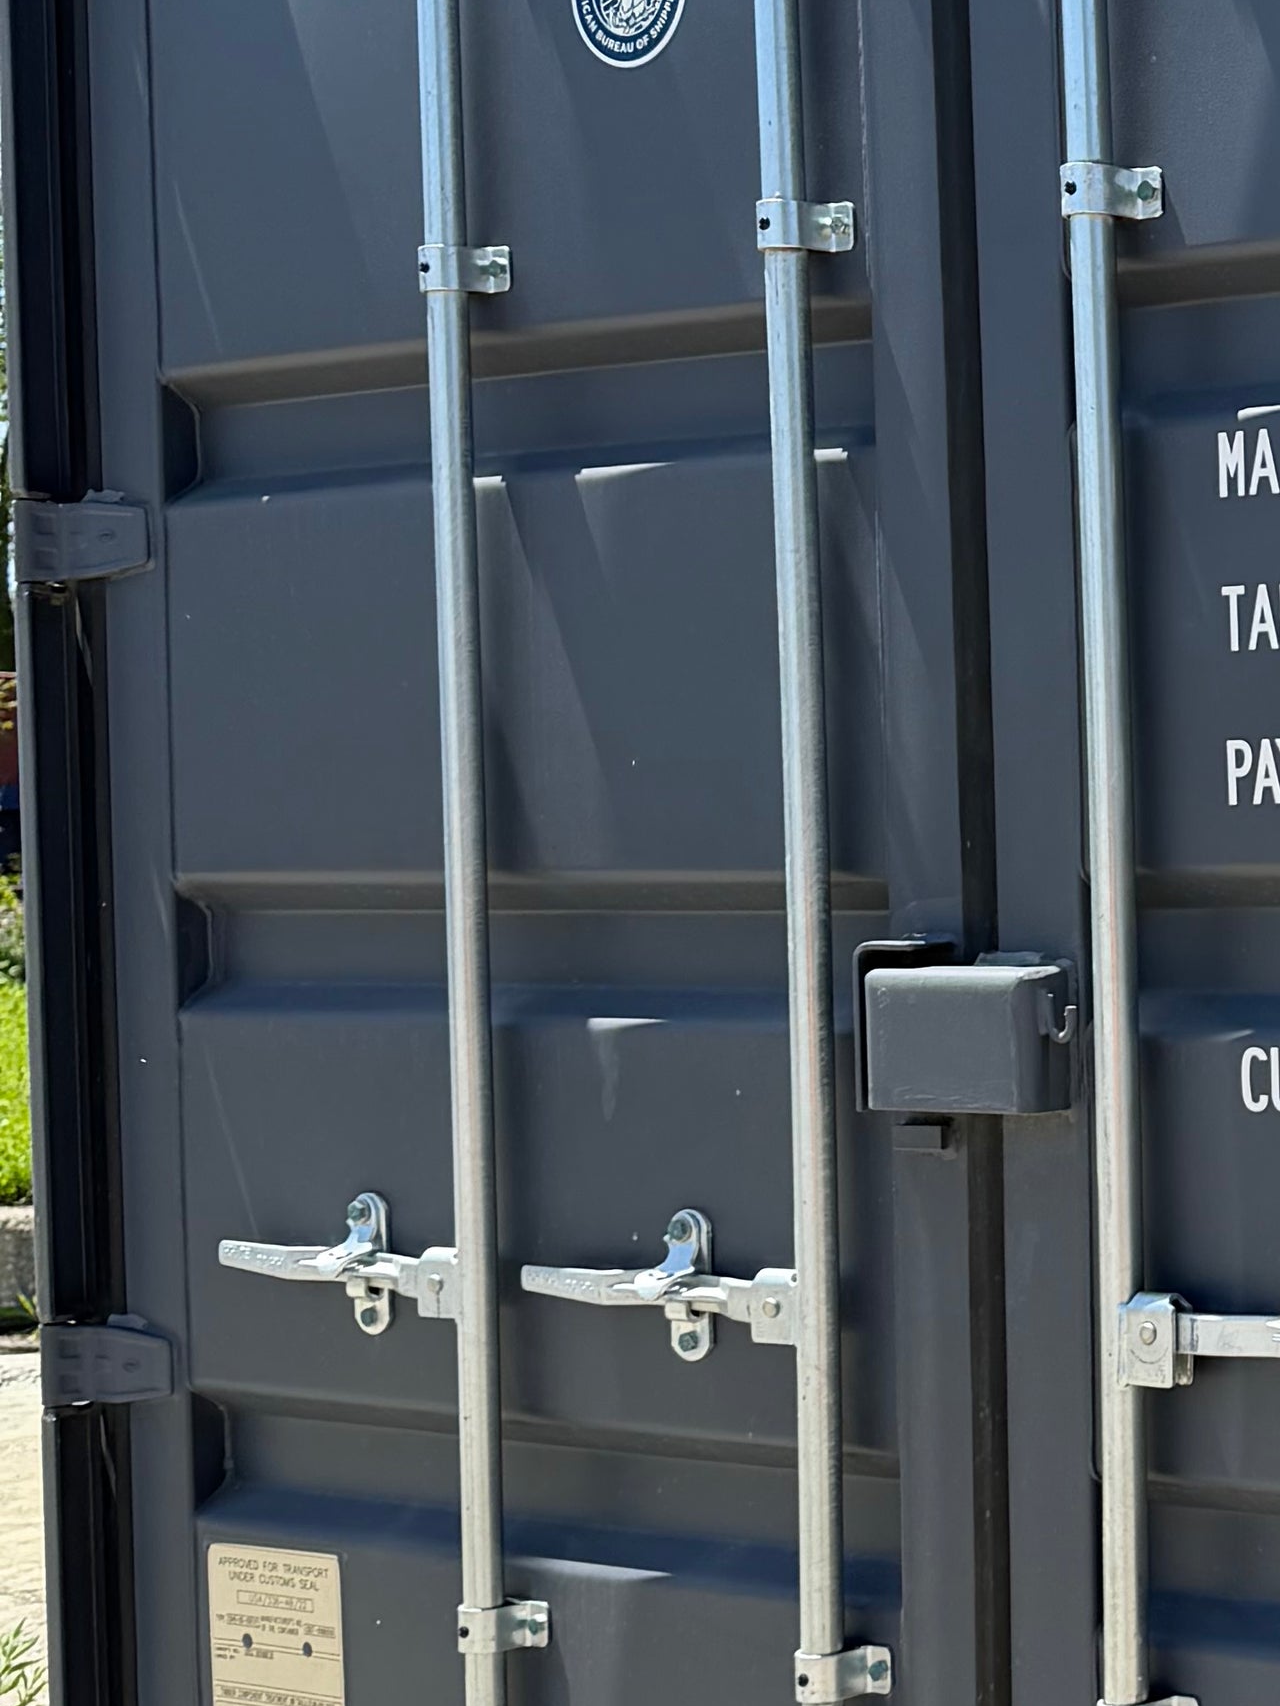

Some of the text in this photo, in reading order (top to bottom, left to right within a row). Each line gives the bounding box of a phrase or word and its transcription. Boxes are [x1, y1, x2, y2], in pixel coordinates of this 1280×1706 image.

[595, 29, 635, 53] BUREAU
[636, 36, 651, 50] OF
[218, 1556, 329, 1579] APPROVED FOR TRANSPORT
[228, 1570, 320, 1592] UNDER CUSTOMS SEAL
